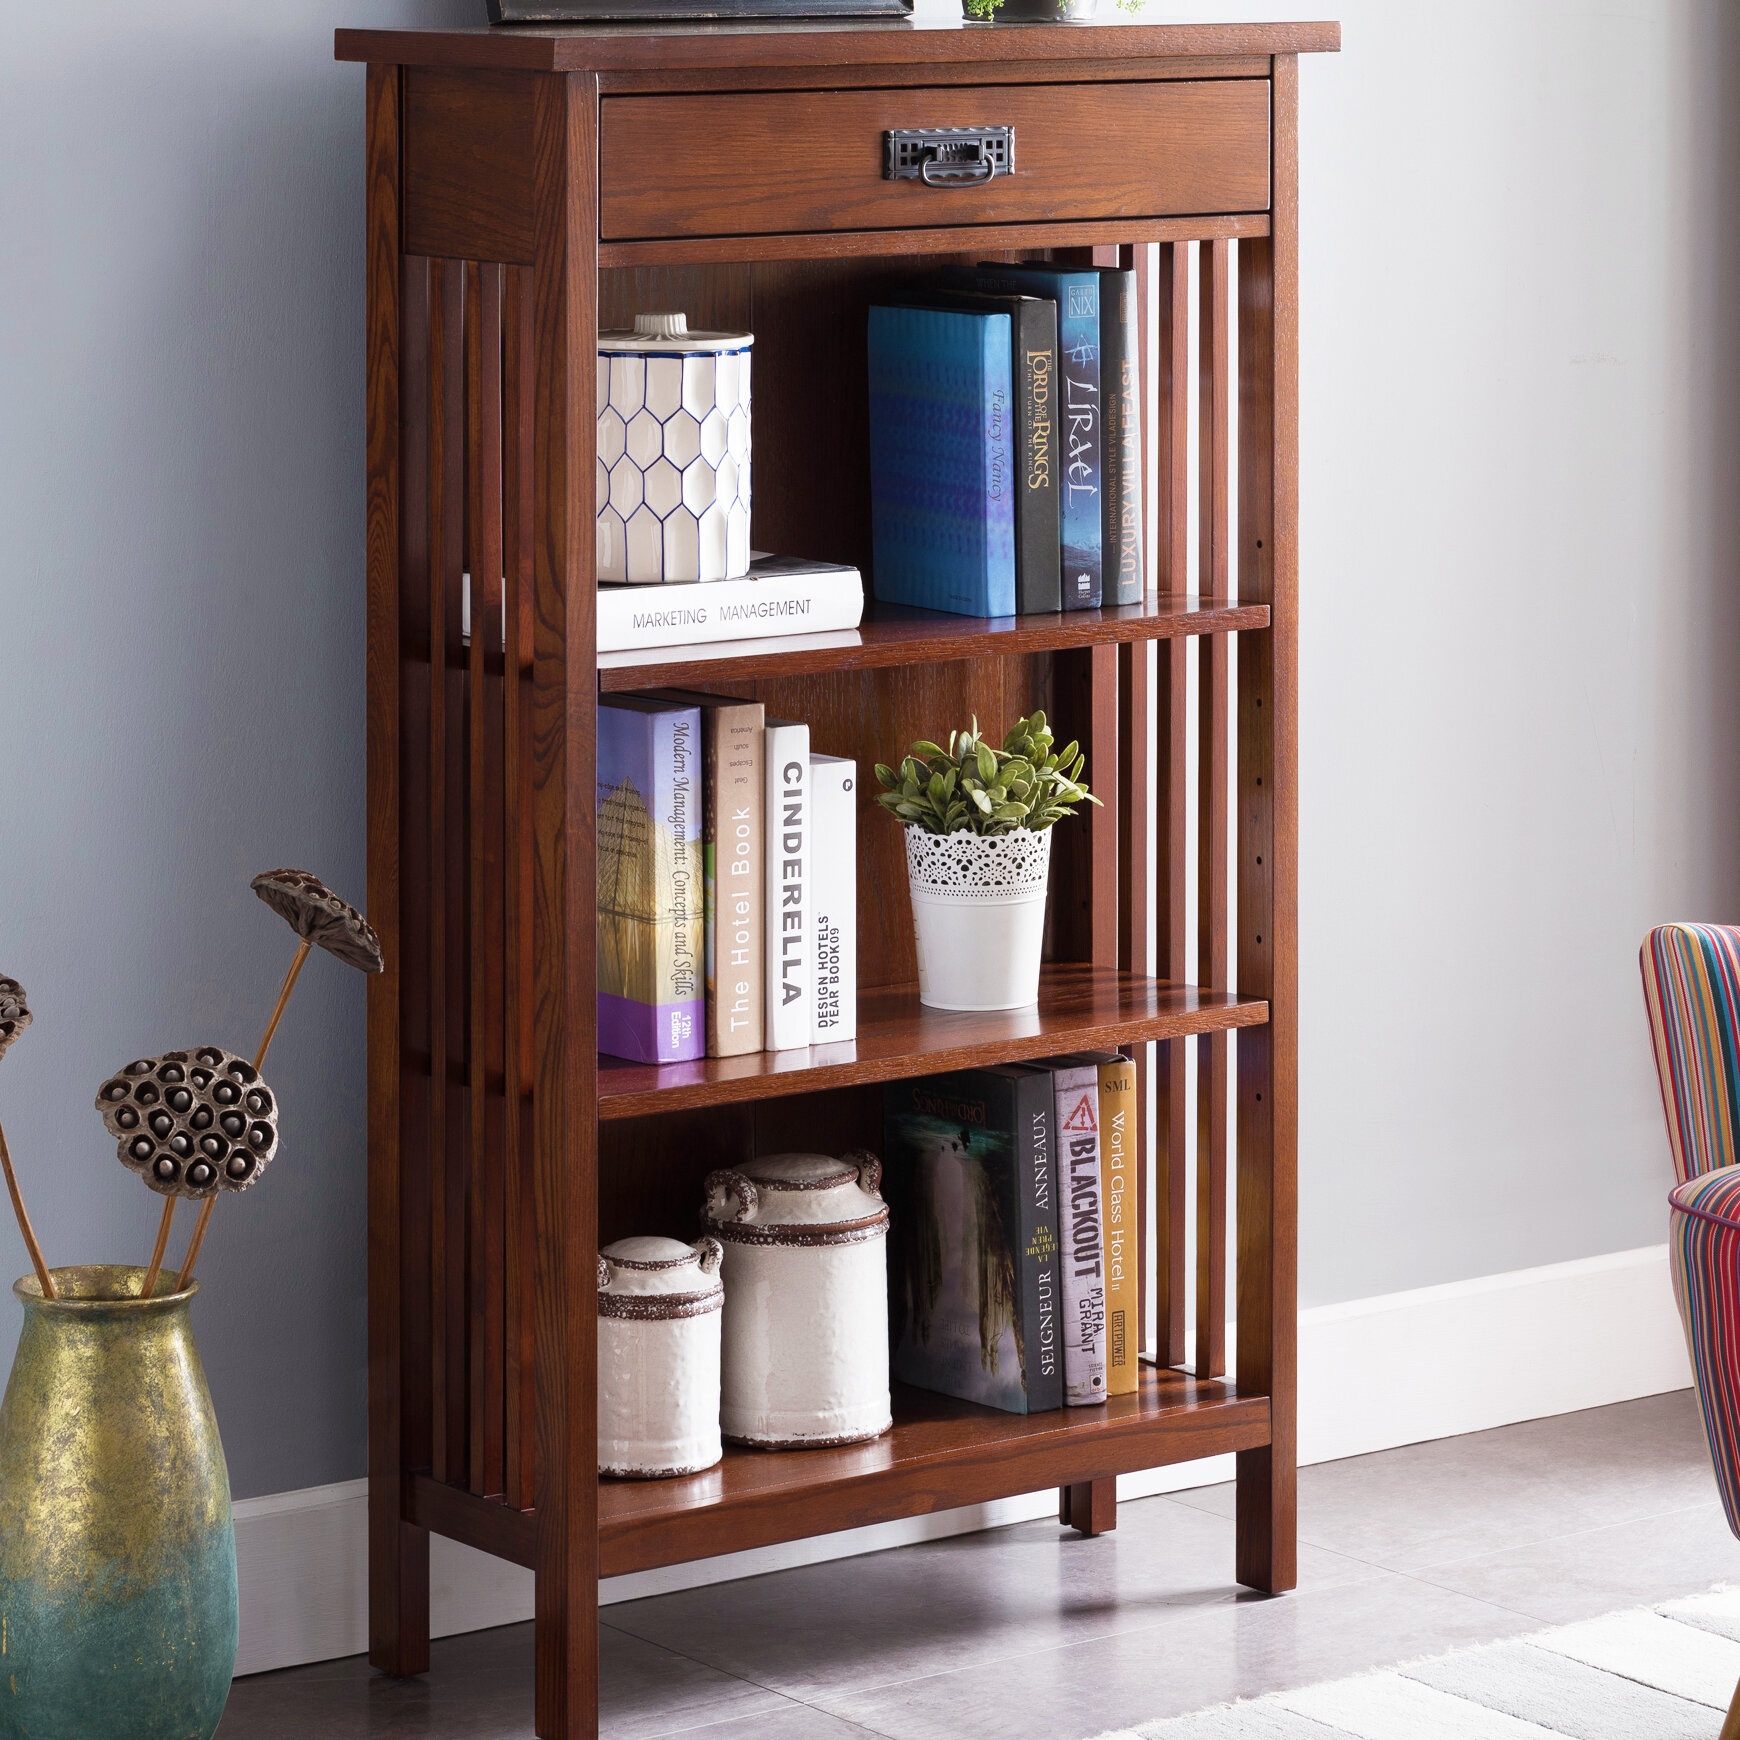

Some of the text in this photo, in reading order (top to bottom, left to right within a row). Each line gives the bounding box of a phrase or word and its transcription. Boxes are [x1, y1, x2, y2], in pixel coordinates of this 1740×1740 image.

[1071, 295, 1093, 315] NIX
[1026, 349, 1052, 404] LORD
[1041, 406, 1047, 419] OF
[988, 389, 1005, 502] Fancy Nancy
[1028, 420, 1051, 489] RINGS
[1108, 447, 1117, 475] STYLE
[1121, 359, 1138, 586] LUXURY VILLA FEAST
[633, 599, 811, 628] MARKETING MANAGEMENT
[729, 759, 753, 768] Escapes
[668, 722, 694, 996] Modern Management: Concepts and Skills
[782, 761, 803, 1006] CINDERELLA
[730, 806, 750, 1033] The Hotel Book
[817, 914, 829, 1029] DESIGN HOTELS
[829, 927, 840, 1028] YEAR BOOK09
[671, 1011, 681, 1049] Edition
[681, 1014, 692, 1039] 12th
[1103, 1079, 1131, 1094] SML
[1111, 1110, 1125, 1170] World
[1069, 1136, 1100, 1278] BLACKOUT
[1110, 1175, 1125, 1223] Class
[1032, 1110, 1055, 1376] SEIGNEUR ANNEAUX
[1111, 1230, 1125, 1280] Hotel
[1079, 1299, 1096, 1355] GRANT
[1090, 1287, 1105, 1334] MIRA
[1112, 1314, 1124, 1367] ARTPOWER
